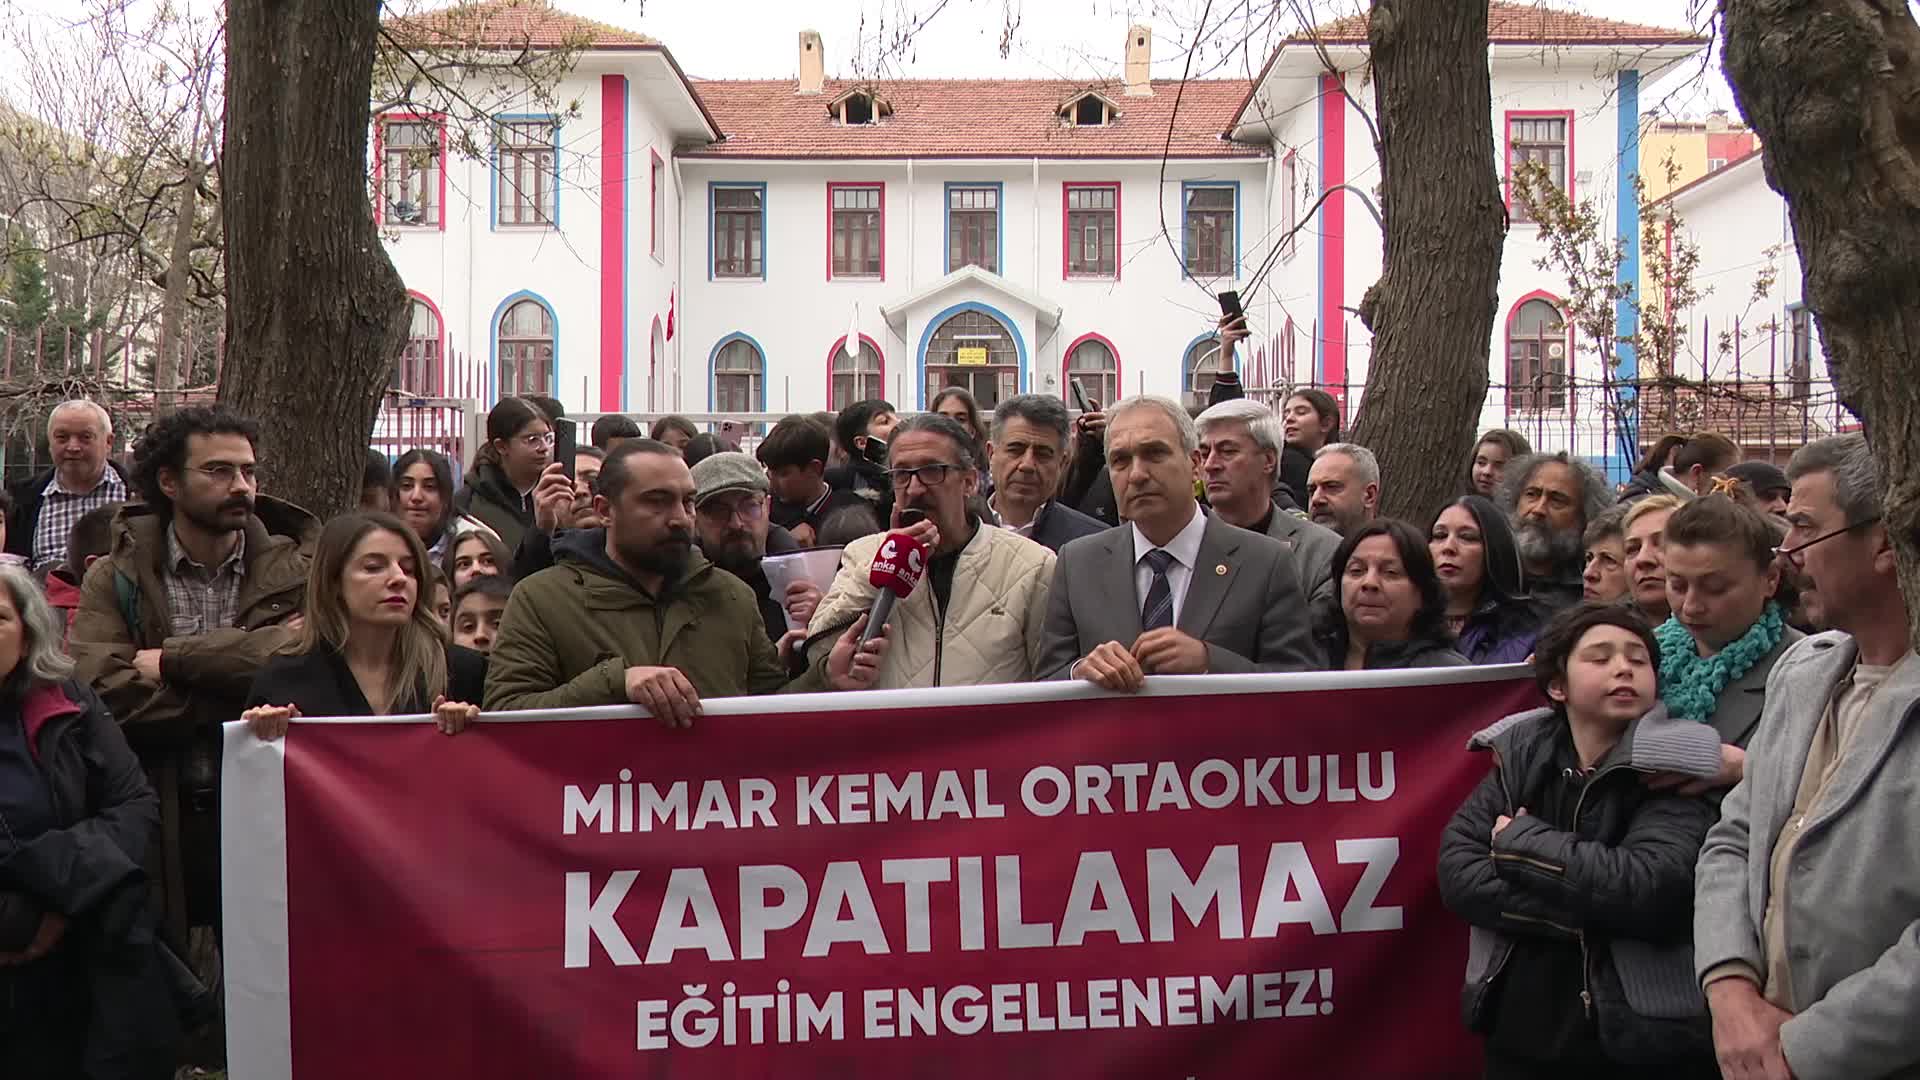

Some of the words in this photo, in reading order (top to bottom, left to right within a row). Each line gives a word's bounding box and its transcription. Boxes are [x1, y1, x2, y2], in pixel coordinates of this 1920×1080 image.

[873, 559, 896, 571] anka
[563, 768, 779, 834] MİMAR
[796, 765, 1005, 826] KEMAL
[1020, 751, 1397, 817] ORTAOKULU
[564, 837, 1403, 969] KAPATILAMAZ
[637, 979, 845, 1051] EĞİTİM
[863, 967, 1335, 1040] ENGELLENEMEZ!
